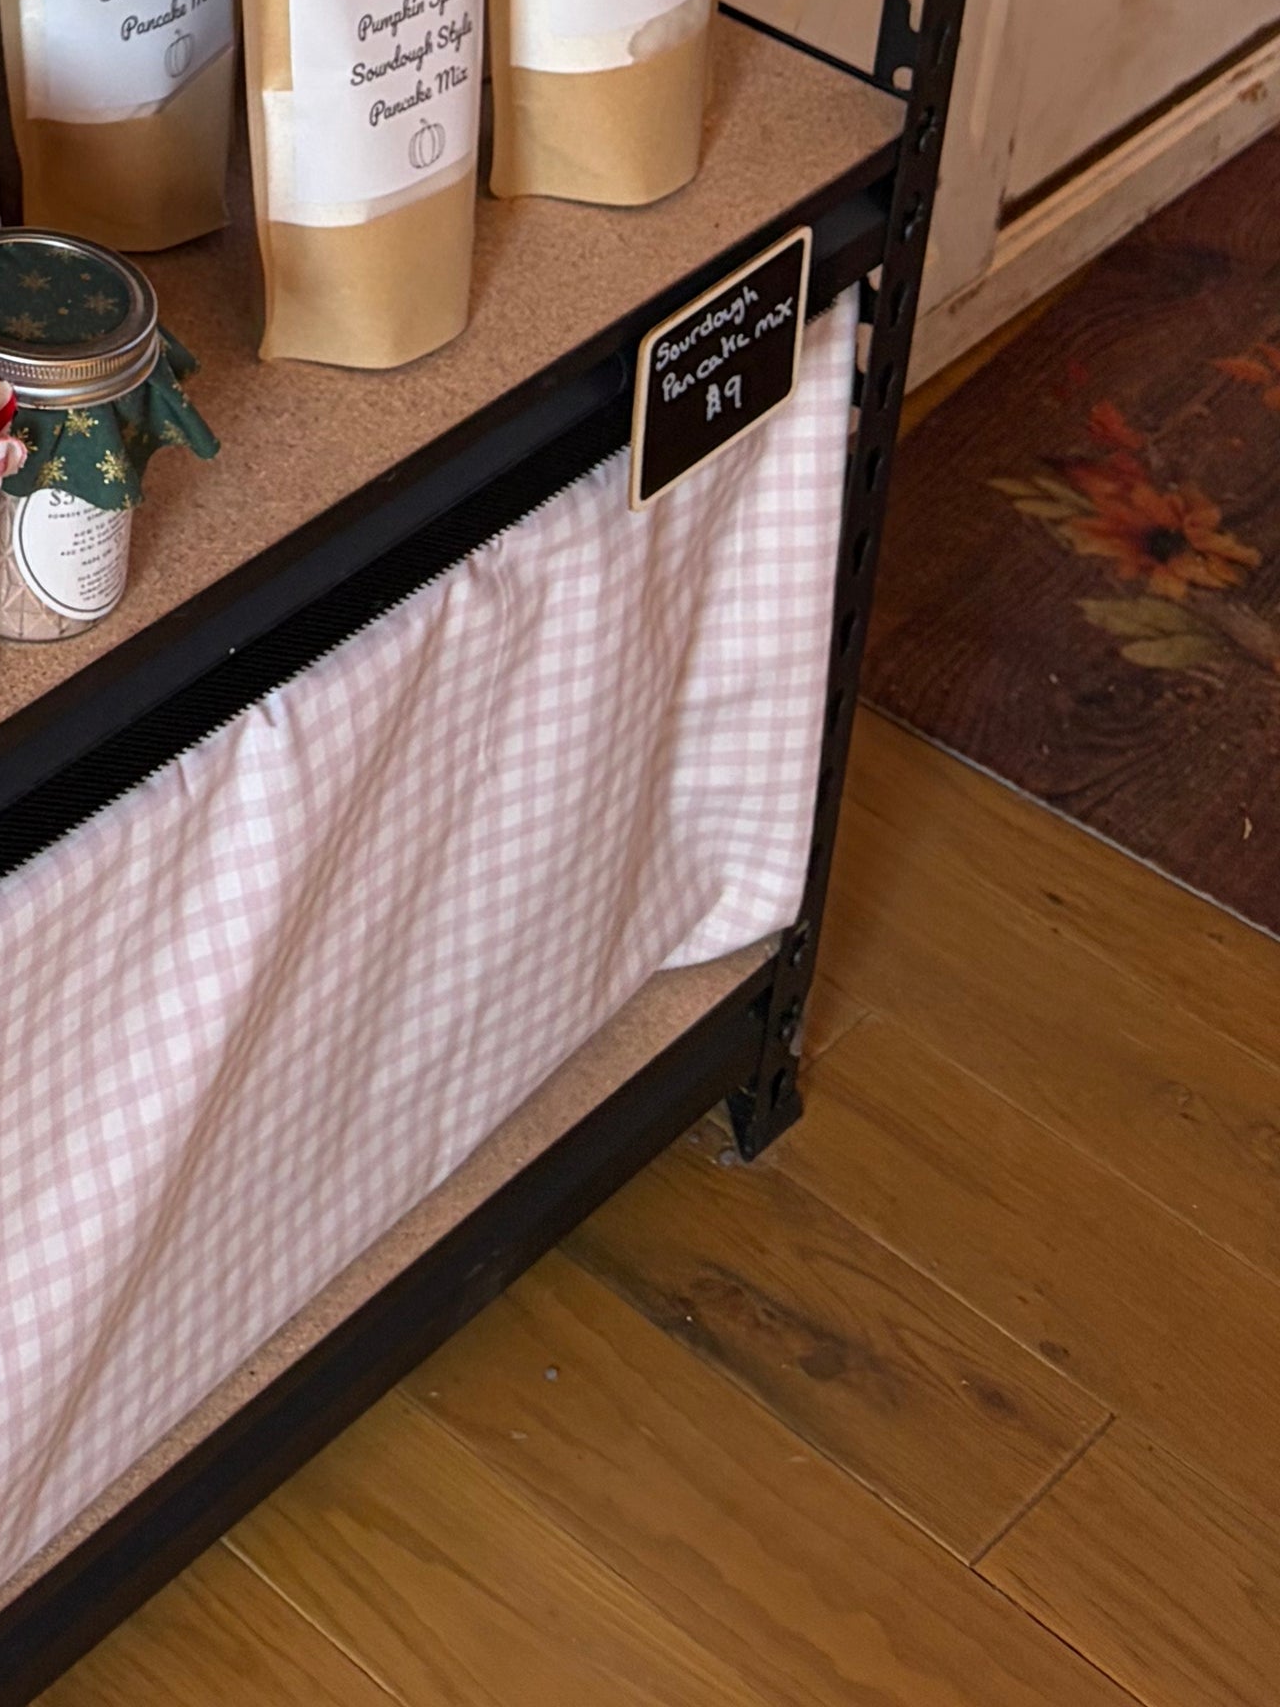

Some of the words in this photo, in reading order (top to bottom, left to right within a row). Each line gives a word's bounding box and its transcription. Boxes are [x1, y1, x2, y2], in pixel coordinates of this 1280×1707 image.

[349, 30, 435, 87] Sourdough
[436, 11, 474, 52] Style
[368, 78, 433, 128] Pancake
[434, 64, 469, 95] Mix
[654, 285, 760, 372] Sourdough
[661, 333, 752, 402] Pancake
